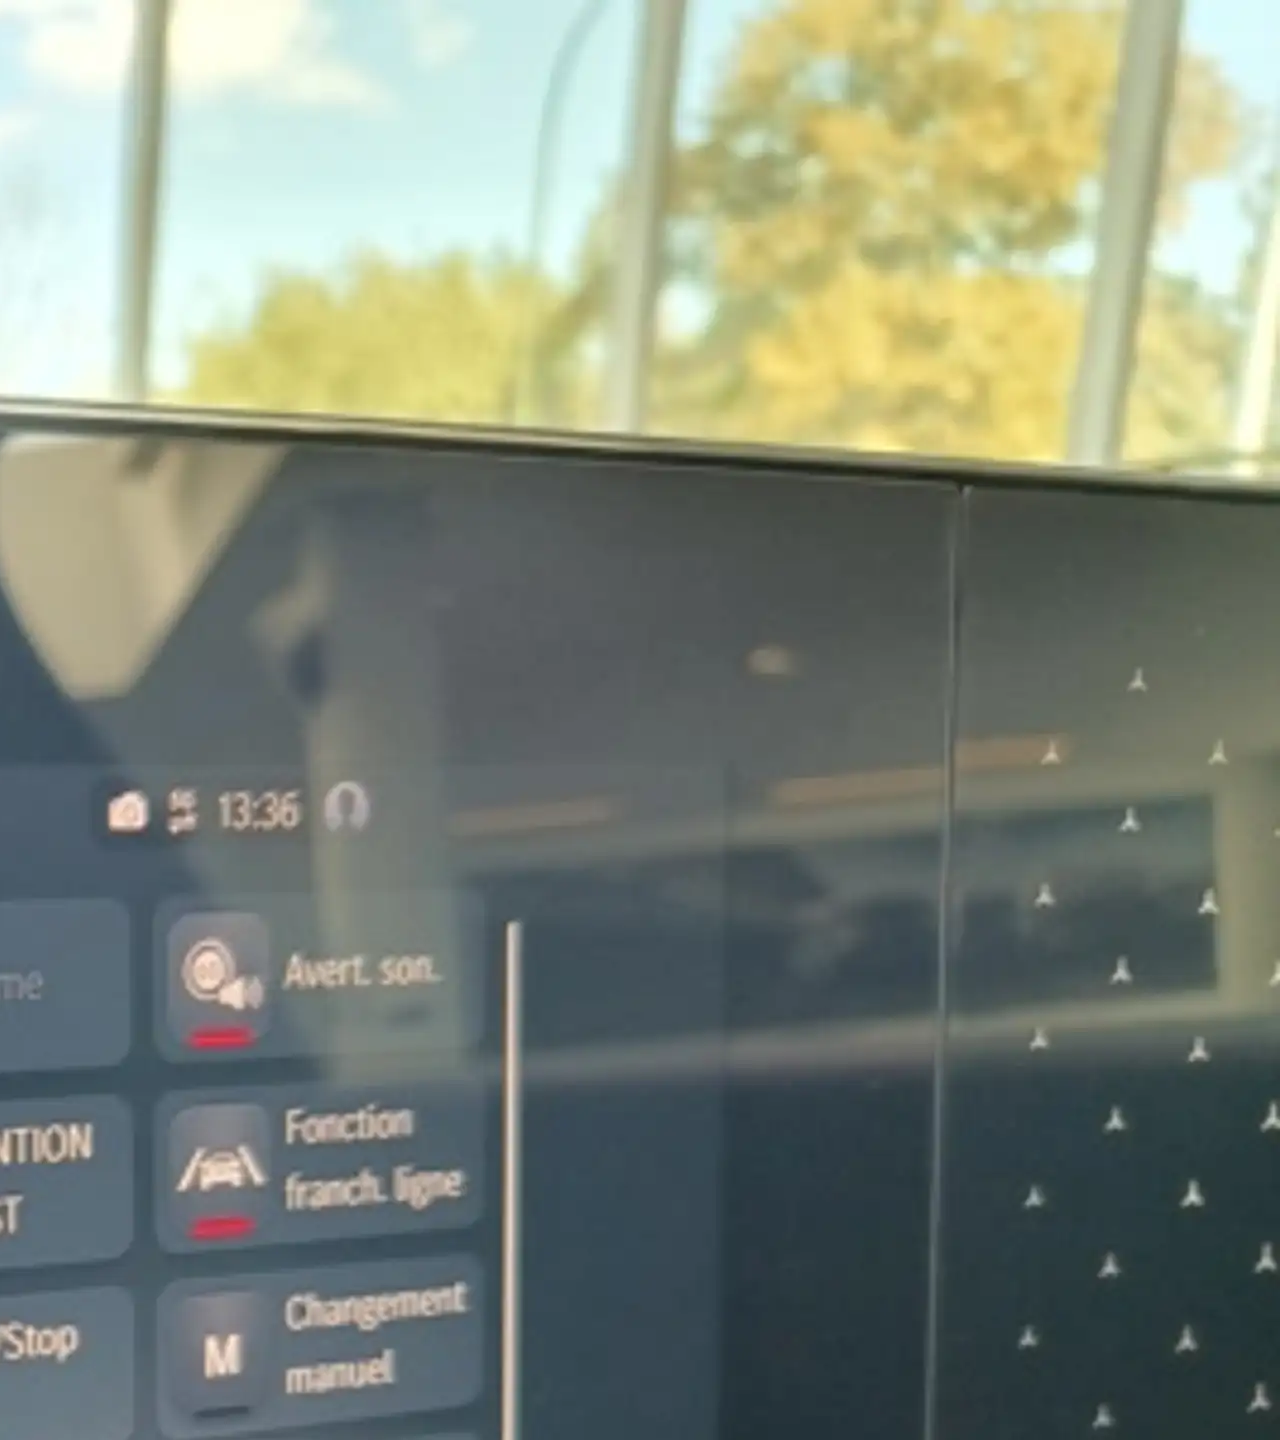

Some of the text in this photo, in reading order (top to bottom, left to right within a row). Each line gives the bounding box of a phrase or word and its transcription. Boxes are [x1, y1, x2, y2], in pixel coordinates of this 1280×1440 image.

[218, 789, 301, 831] 13:36
[282, 951, 443, 991] Avert. son.
[285, 1101, 414, 1146] Fonction
[285, 1165, 467, 1212] franch. ligne
[285, 1281, 469, 1333] Changement
[203, 1333, 243, 1379] M
[286, 1349, 397, 1395] manuel
